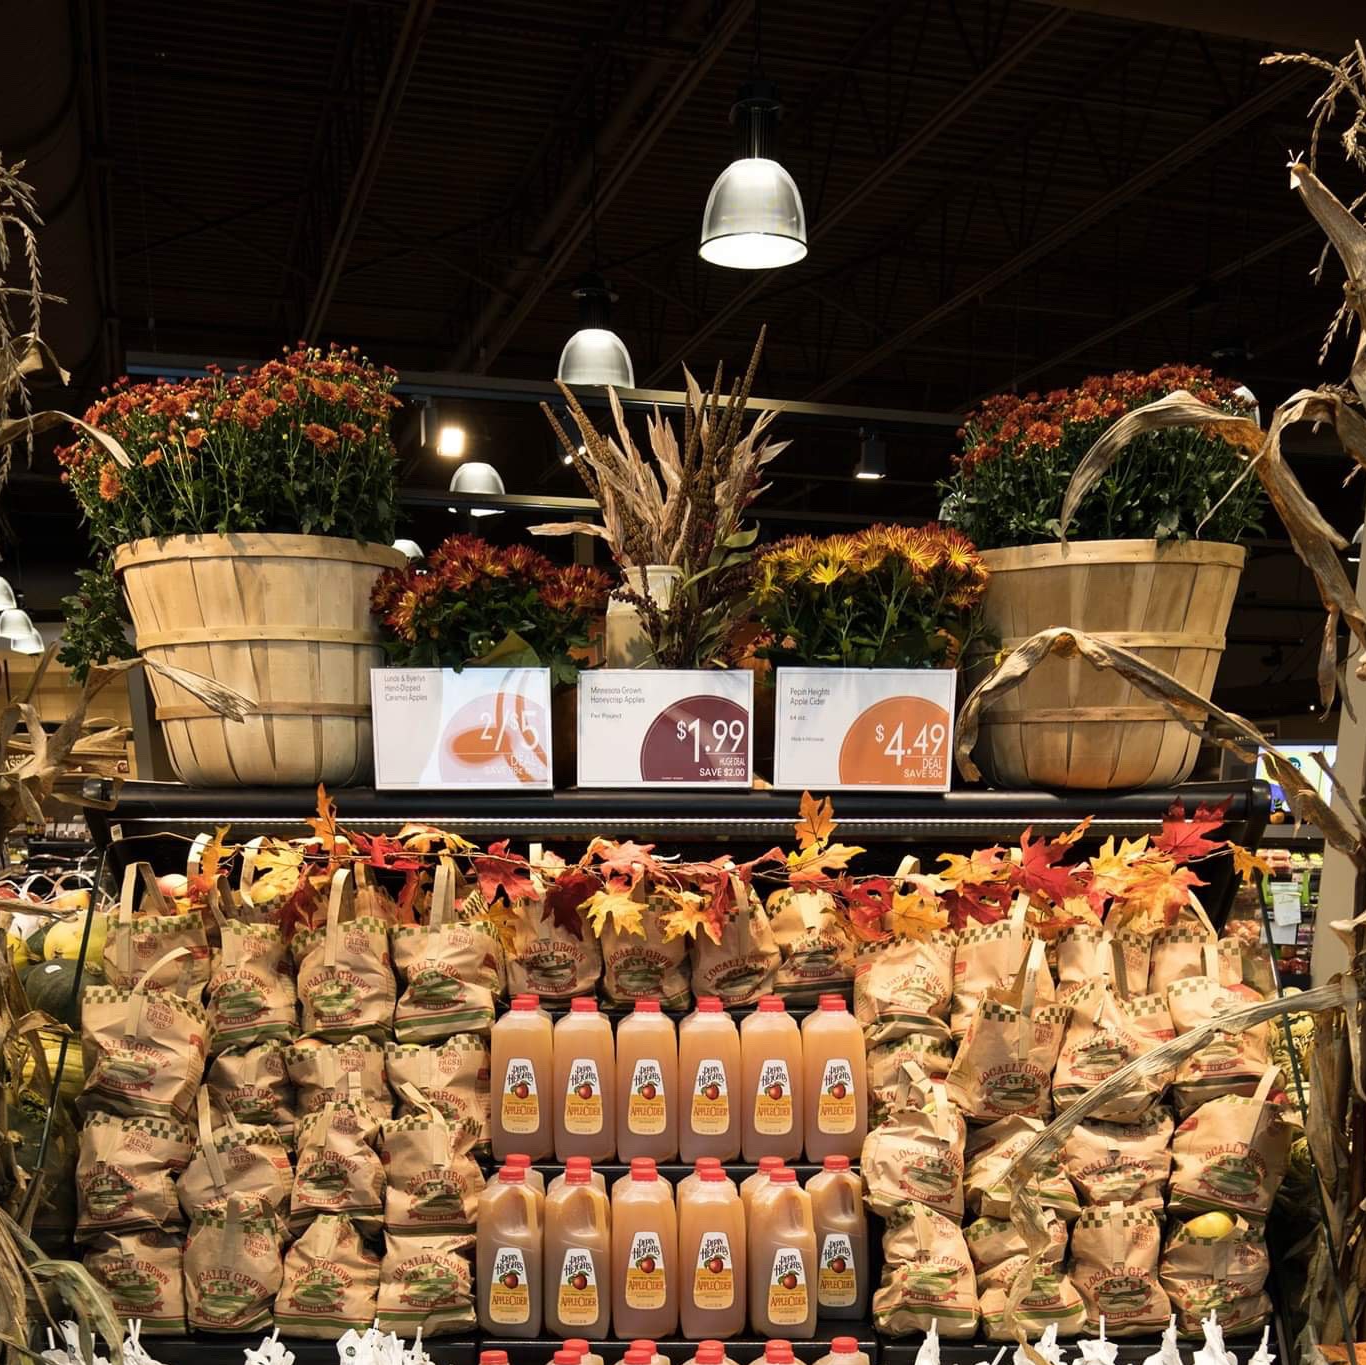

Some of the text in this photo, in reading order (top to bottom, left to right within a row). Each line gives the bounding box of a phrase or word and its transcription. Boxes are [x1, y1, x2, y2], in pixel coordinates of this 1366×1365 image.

[590, 686, 642, 695] Minnesota Grown
[790, 688, 830, 697] Pepin Heights
[590, 696, 645, 705] Honeycrisp Apples
[790, 697, 826, 706] Apple Cider
[676, 717, 745, 763] $1.99
[875, 720, 945, 766] $4.49
[922, 758, 943, 769] DEAL
[699, 768, 745, 778] SAVE $2.00
[903, 768, 927, 778] SAVE
[703, 957, 744, 982] LOCALLY
[511, 1064, 529, 1074] PEPIN
[575, 1064, 592, 1075] PEPIN
[638, 1065, 656, 1075] PEPIN
[702, 1065, 720, 1075] PEPIN
[766, 1065, 783, 1075] PEPIN
[829, 1065, 846, 1075] PEPIN
[978, 1062, 1025, 1085] LOCALLY
[432, 1090, 468, 1112] GROWN
[322, 1150, 360, 1175] GROWN
[637, 1238, 655, 1248] PEPIN
[706, 1238, 724, 1248] PEPIN
[828, 1239, 846, 1249] PEPIN
[500, 1253, 519, 1264] PEPIN
[568, 1254, 587, 1265] PEPIN
[779, 1254, 797, 1265] PEPIN
[392, 1253, 436, 1281] LOCALLY
[932, 1255, 969, 1277] GROWN
[135, 1261, 171, 1286] GROWN
[1084, 1267, 1126, 1291] LOCALLY
[234, 1272, 269, 1299] GROWN
